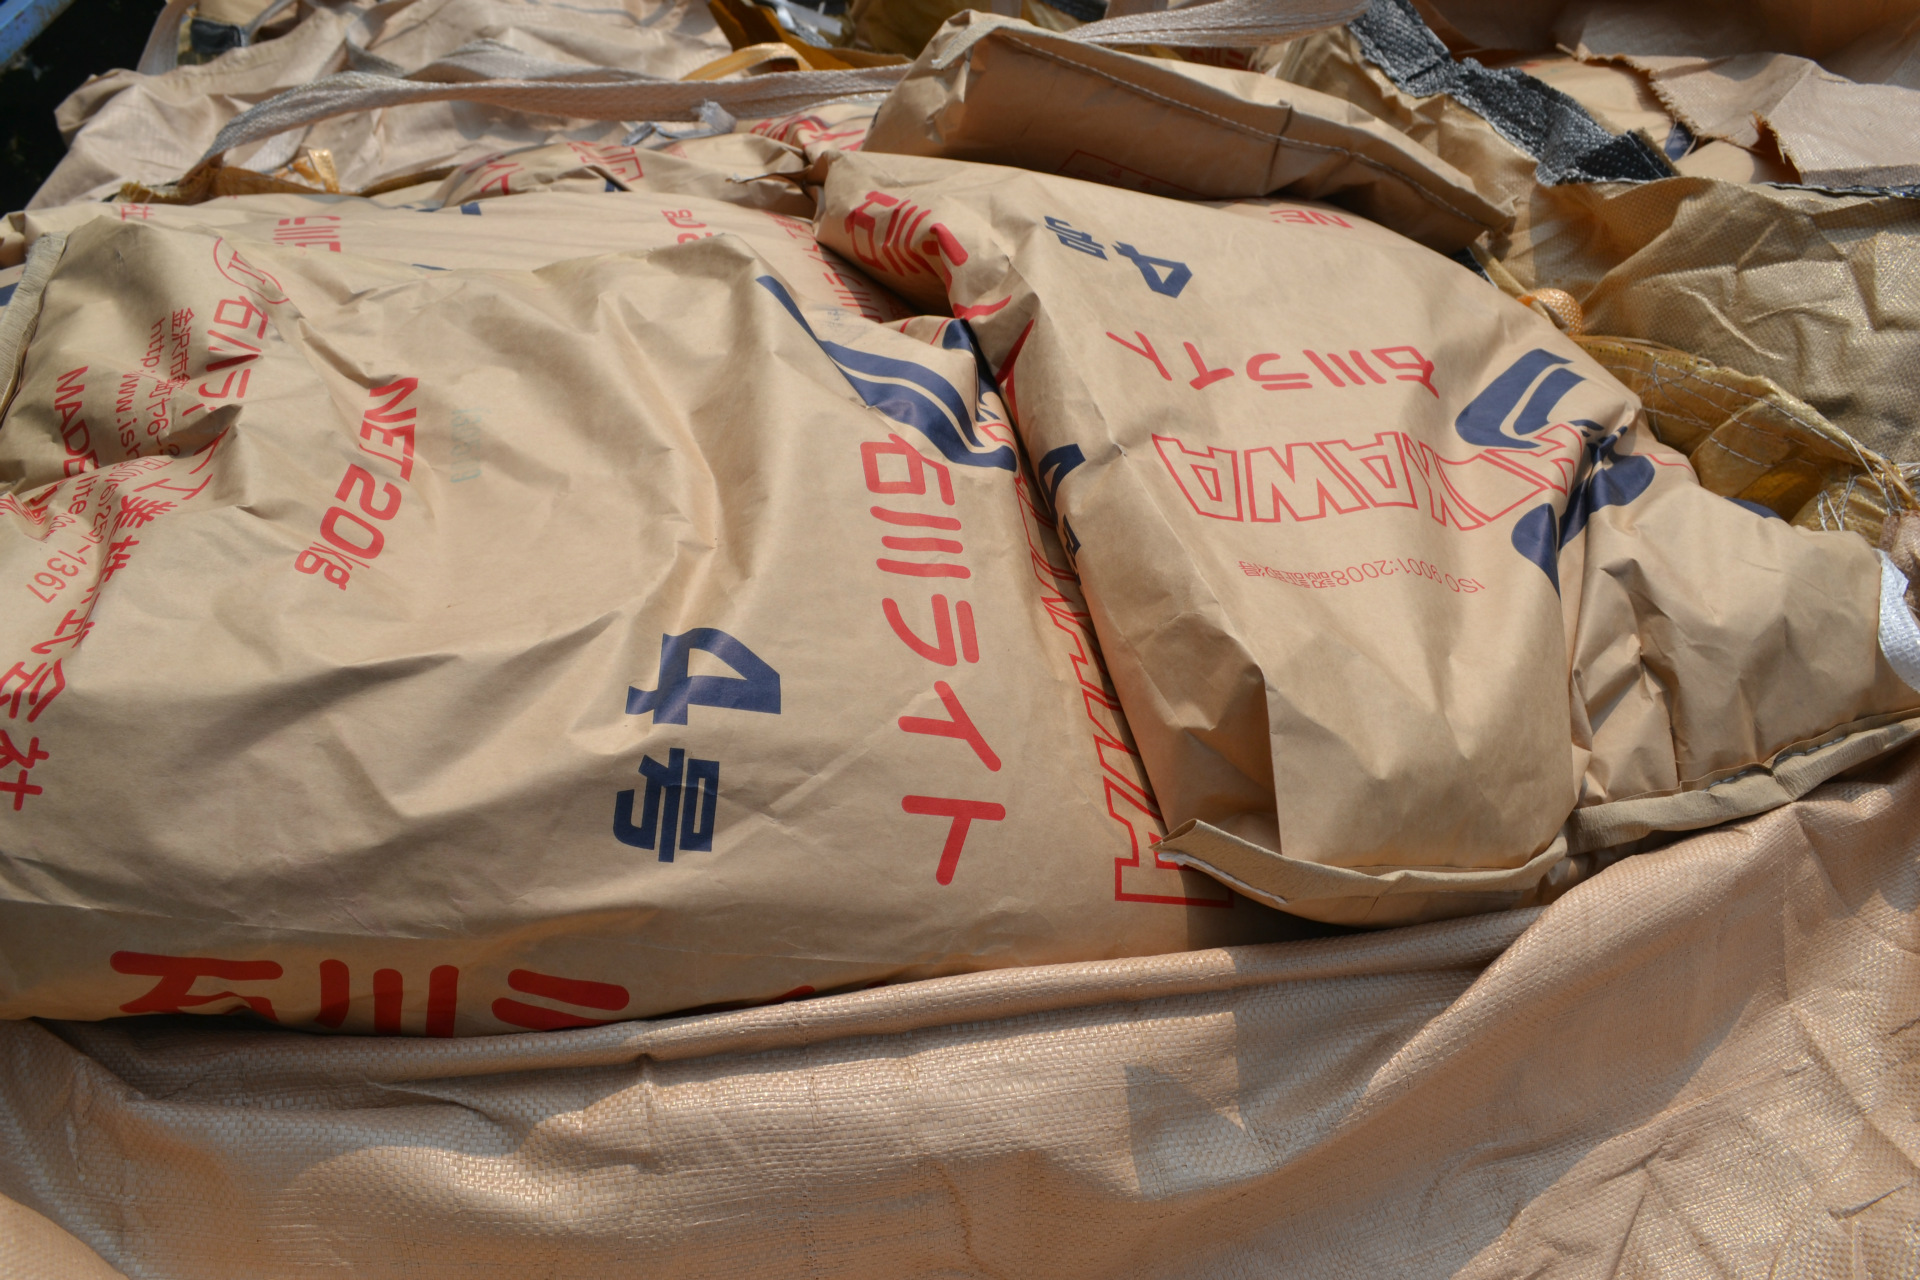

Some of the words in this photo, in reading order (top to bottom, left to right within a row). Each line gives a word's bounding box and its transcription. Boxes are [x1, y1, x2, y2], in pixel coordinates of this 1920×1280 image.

[1044, 215, 1193, 299] 4号
[1269, 208, 1355, 230] NE
[1105, 330, 1440, 400] 石川ライト
[359, 377, 419, 482] NET
[294, 463, 403, 591] 20kg
[1443, 573, 1486, 594] ISO
[859, 432, 1006, 887] 石川ライト
[612, 626, 782, 864] 4号
